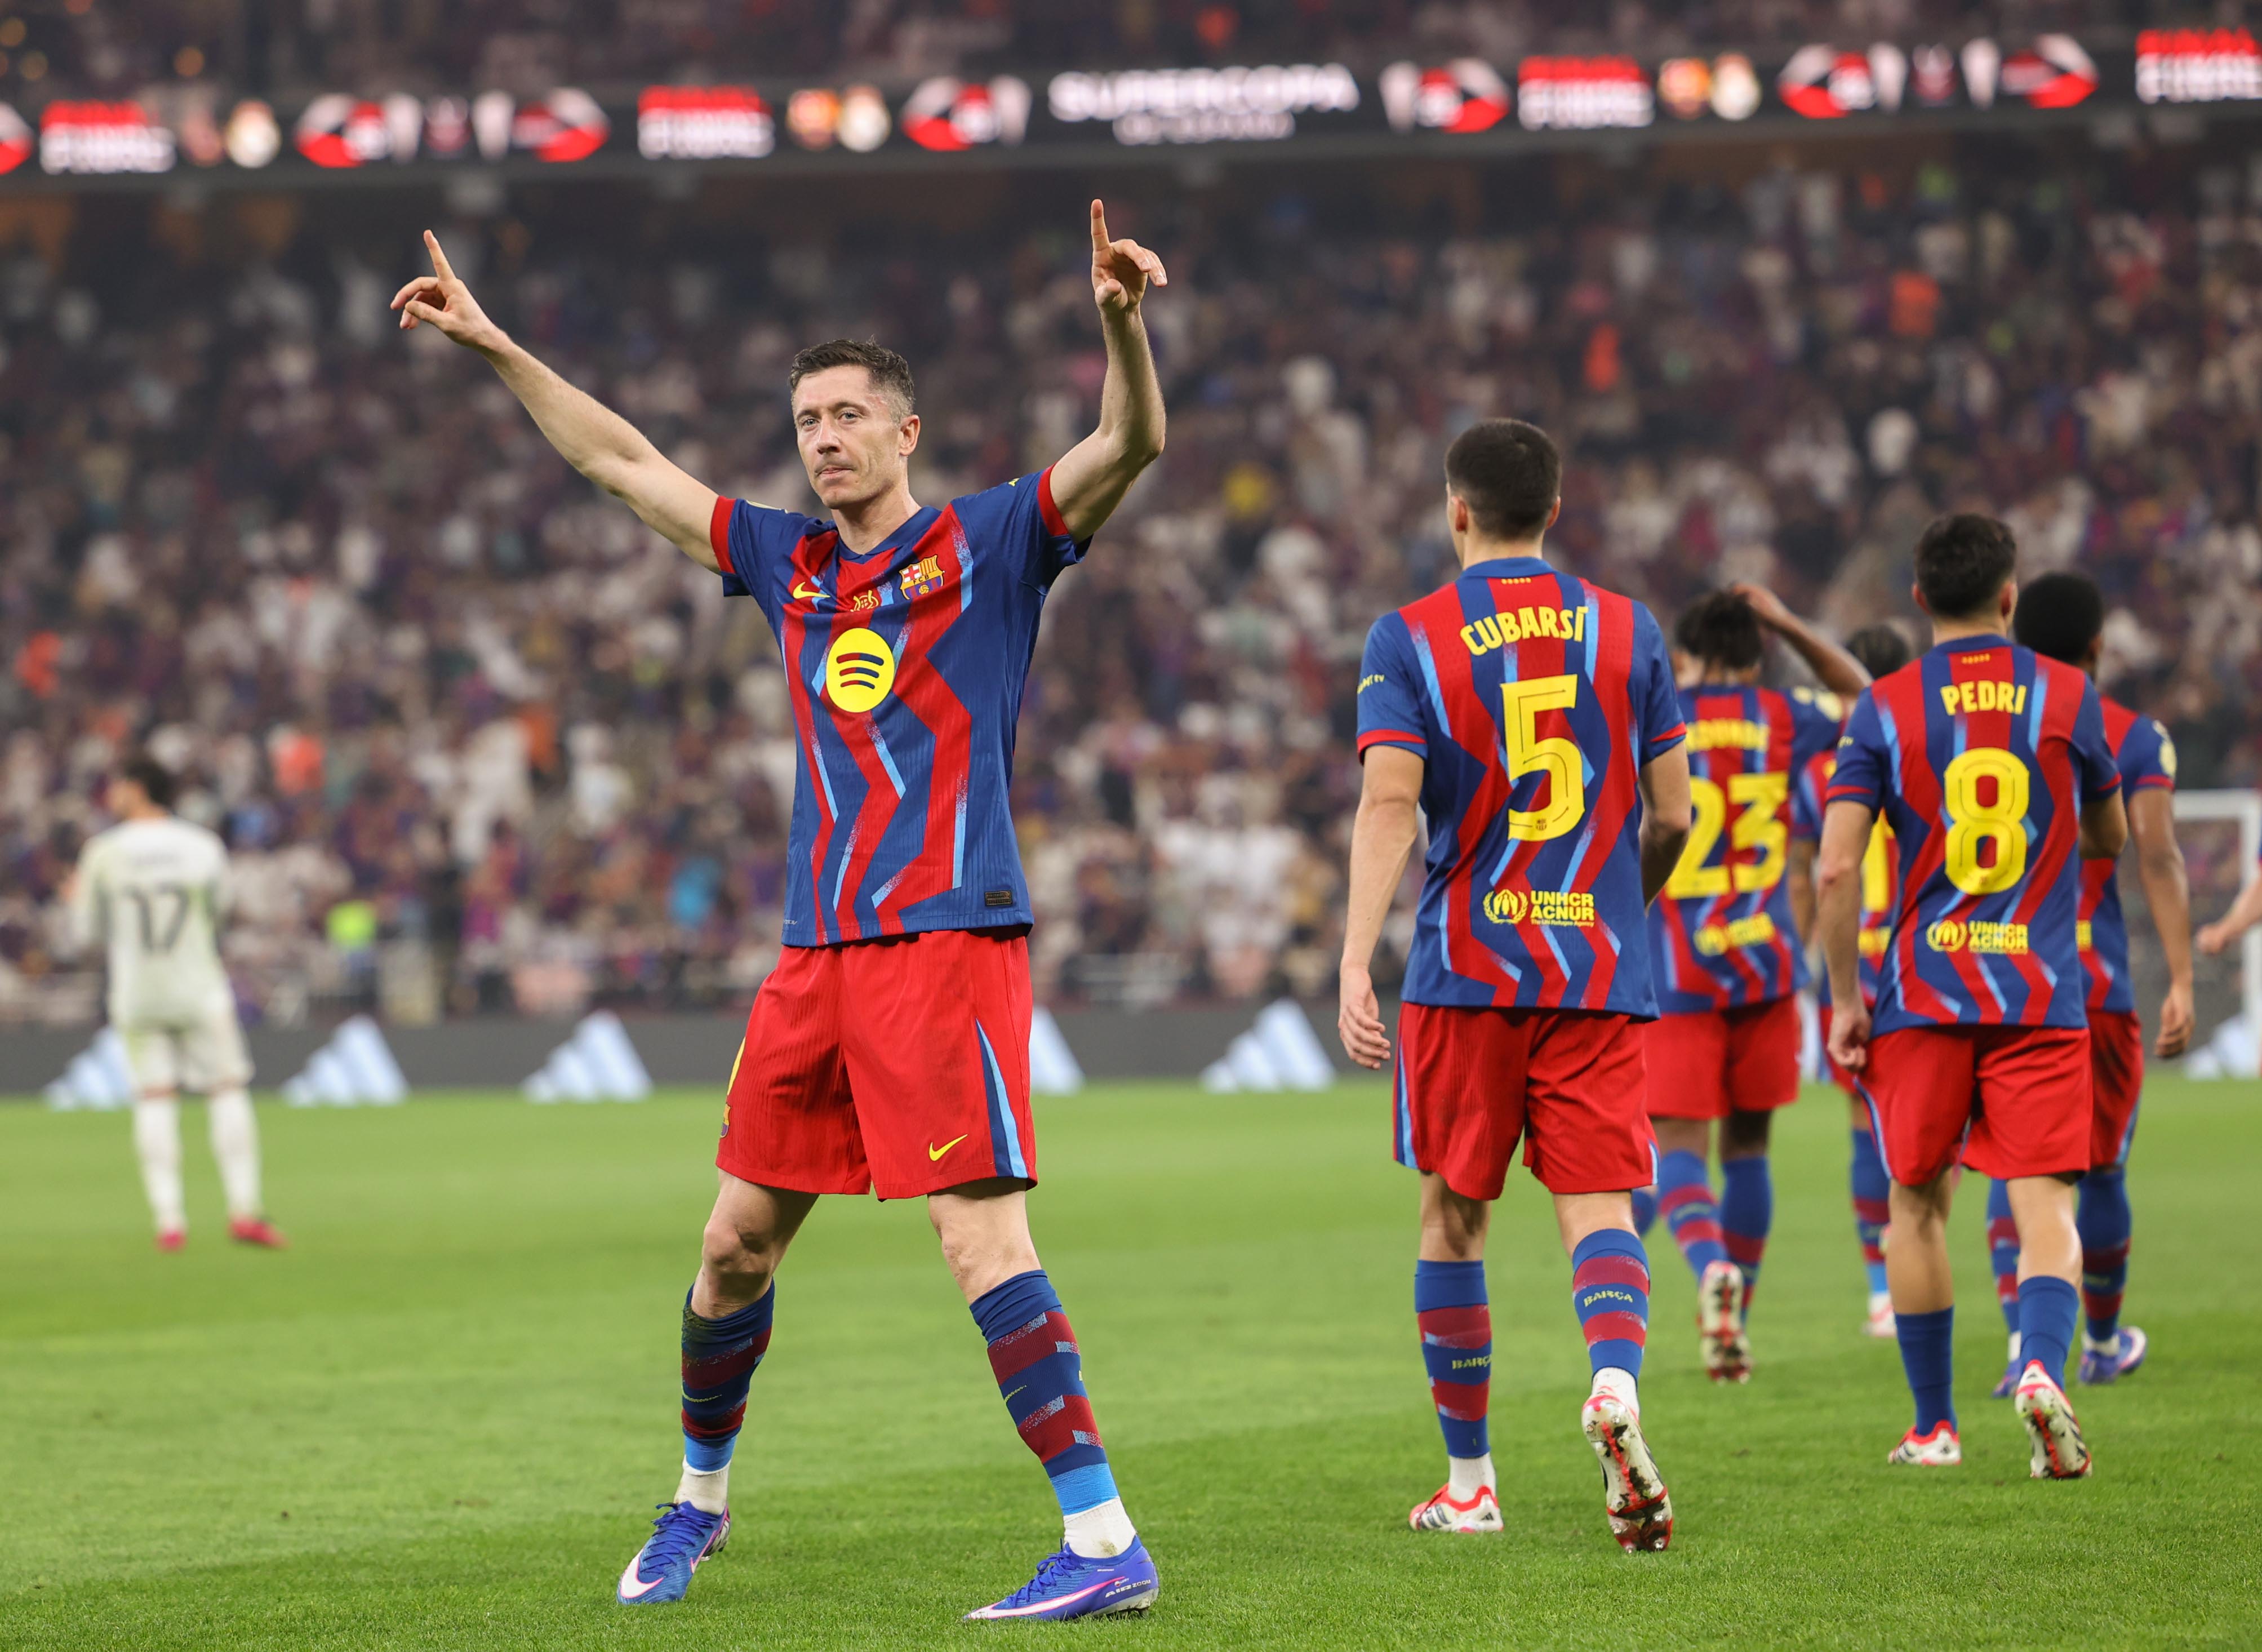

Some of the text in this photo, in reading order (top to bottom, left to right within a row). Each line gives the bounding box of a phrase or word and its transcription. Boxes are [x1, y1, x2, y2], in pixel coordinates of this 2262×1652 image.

[1460, 606, 1589, 656] CUBARSÍ
[1940, 680, 2027, 716] PEDRI
[1500, 674, 1585, 841] 5
[1666, 771, 1789, 900] 23
[1944, 747, 2030, 896] 8
[122, 882, 190, 954] 17
[1530, 890, 1594, 907] UNHCR
[1530, 905, 1595, 921] ACNUR
[1584, 1290, 1633, 1307] BARÇA
[1105, 1584, 1131, 1598] AIR
[1132, 1579, 1151, 1588] ZOOM
